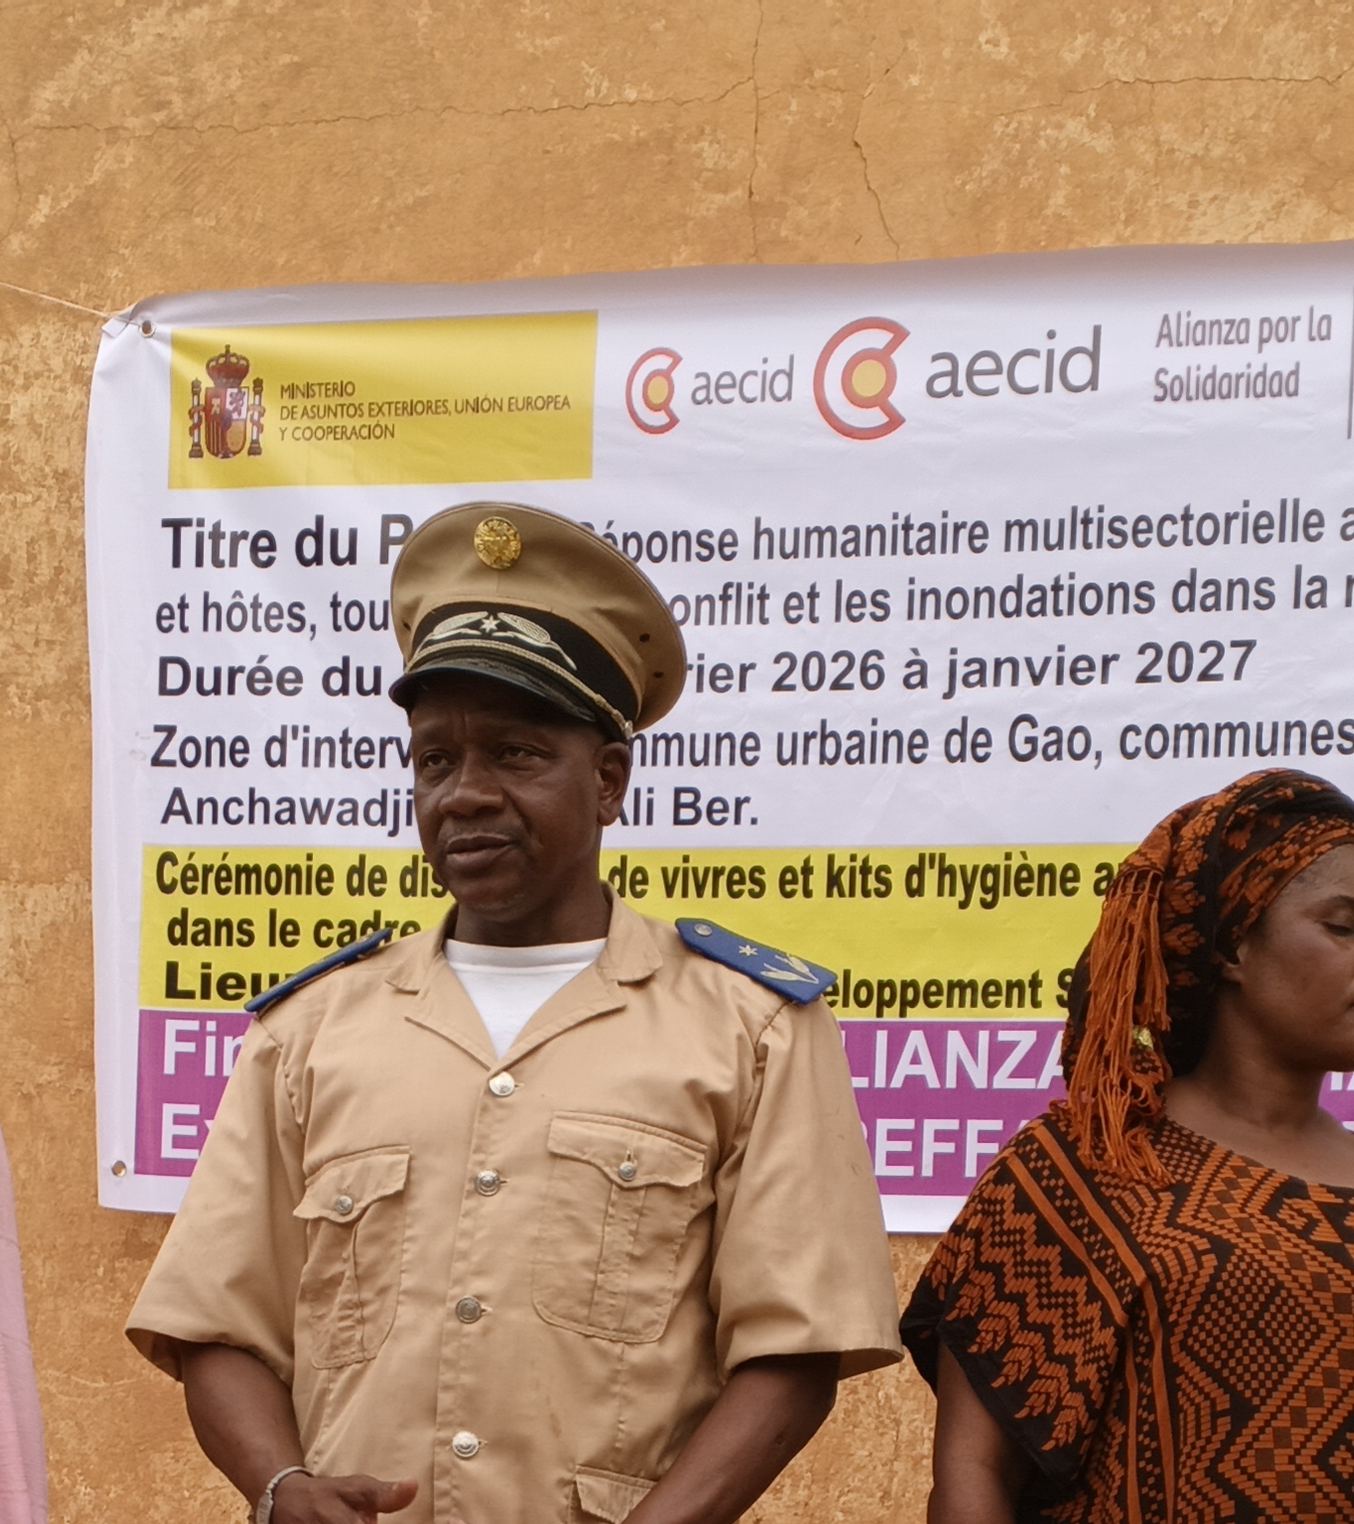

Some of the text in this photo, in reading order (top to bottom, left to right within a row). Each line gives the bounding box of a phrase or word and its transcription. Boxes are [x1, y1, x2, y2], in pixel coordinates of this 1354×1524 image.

[1155, 306, 1334, 353] Alianza por la
[690, 354, 796, 405] aecid
[925, 324, 1102, 400] aecid
[1153, 361, 1301, 403] Solidaridad
[280, 381, 356, 399] MINISTERIO
[280, 394, 571, 421] DE ASUNTOS EXTERIORES, UNIÓN EUROPEA
[279, 419, 395, 441] Y COOPERACIÓN
[161, 516, 278, 569] Titre
[294, 513, 358, 567] du
[753, 510, 990, 560] humanitaire
[1002, 498, 1326, 552] multisectorielle
[155, 595, 189, 634] et
[202, 590, 318, 641] hôtes,
[669, 581, 771, 627] onflit
[782, 581, 821, 625] et
[834, 578, 892, 624] les
[906, 570, 1156, 621] inondations
[1171, 567, 1277, 613] dans
[1293, 564, 1328, 610] la
[158, 655, 304, 697] Durée
[321, 655, 383, 697] du
[771, 649, 886, 693] 2026
[902, 647, 930, 690] à
[942, 643, 1120, 701] janvier
[1135, 639, 1258, 684] 2027
[150, 724, 251, 769] Zone
[264, 723, 413, 769] d'interv
[776, 717, 930, 767] urbaine
[943, 715, 993, 763] de
[1008, 712, 1104, 770] Gao,
[672, 786, 760, 828] Ber.
[155, 850, 336, 898] Cérémonie
[346, 852, 389, 898] de
[608, 853, 650, 899] de
[660, 853, 767, 900] vivres
[778, 857, 814, 899] et
[825, 852, 893, 899] kits
[904, 850, 1082, 911] d'hygiène
[166, 906, 256, 948] dans
[268, 908, 302, 948] le
